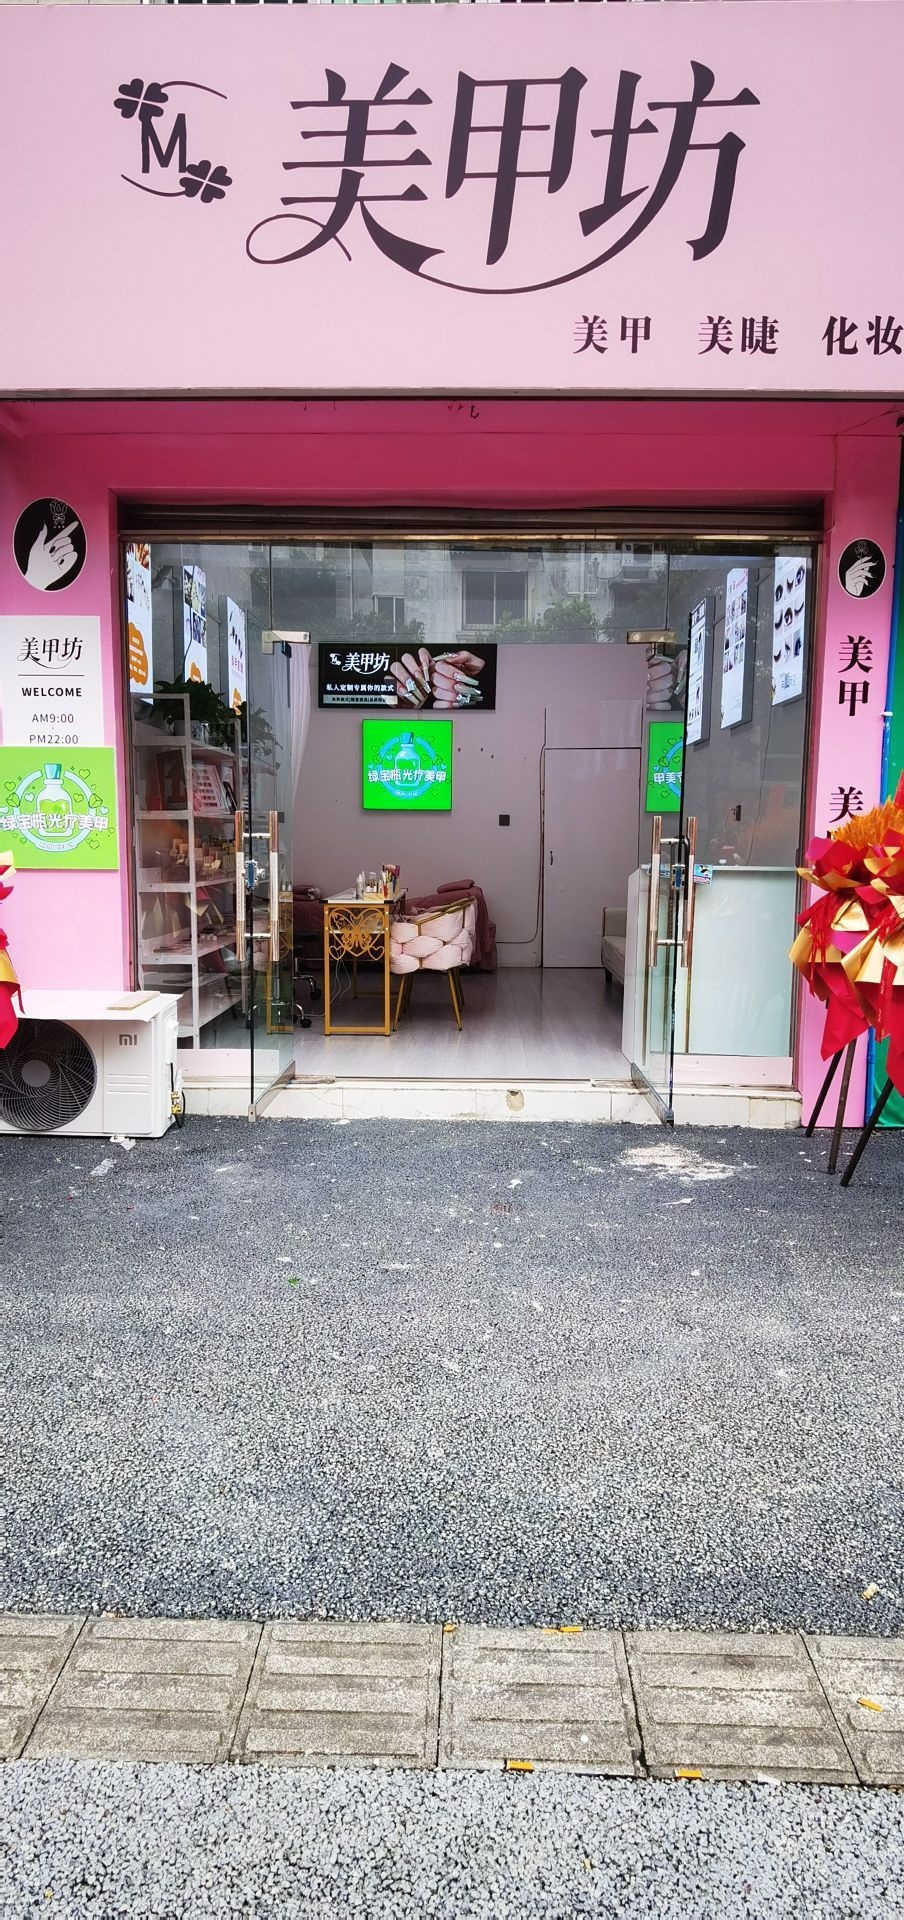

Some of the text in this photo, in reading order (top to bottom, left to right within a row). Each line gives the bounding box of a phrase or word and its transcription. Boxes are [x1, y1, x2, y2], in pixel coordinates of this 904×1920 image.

[140, 112, 188, 174] M
[246, 60, 761, 295] 美甲坊
[573, 314, 904, 356] 美甲 美睫 化妆
[17, 636, 83, 669] 美甲坊
[341, 652, 390, 675] 美甲坊
[21, 687, 82, 697] WELCOME
[838, 634, 873, 717] 美甲
[31, 713, 74, 723] AM9:00
[29, 734, 79, 744] PM22:00
